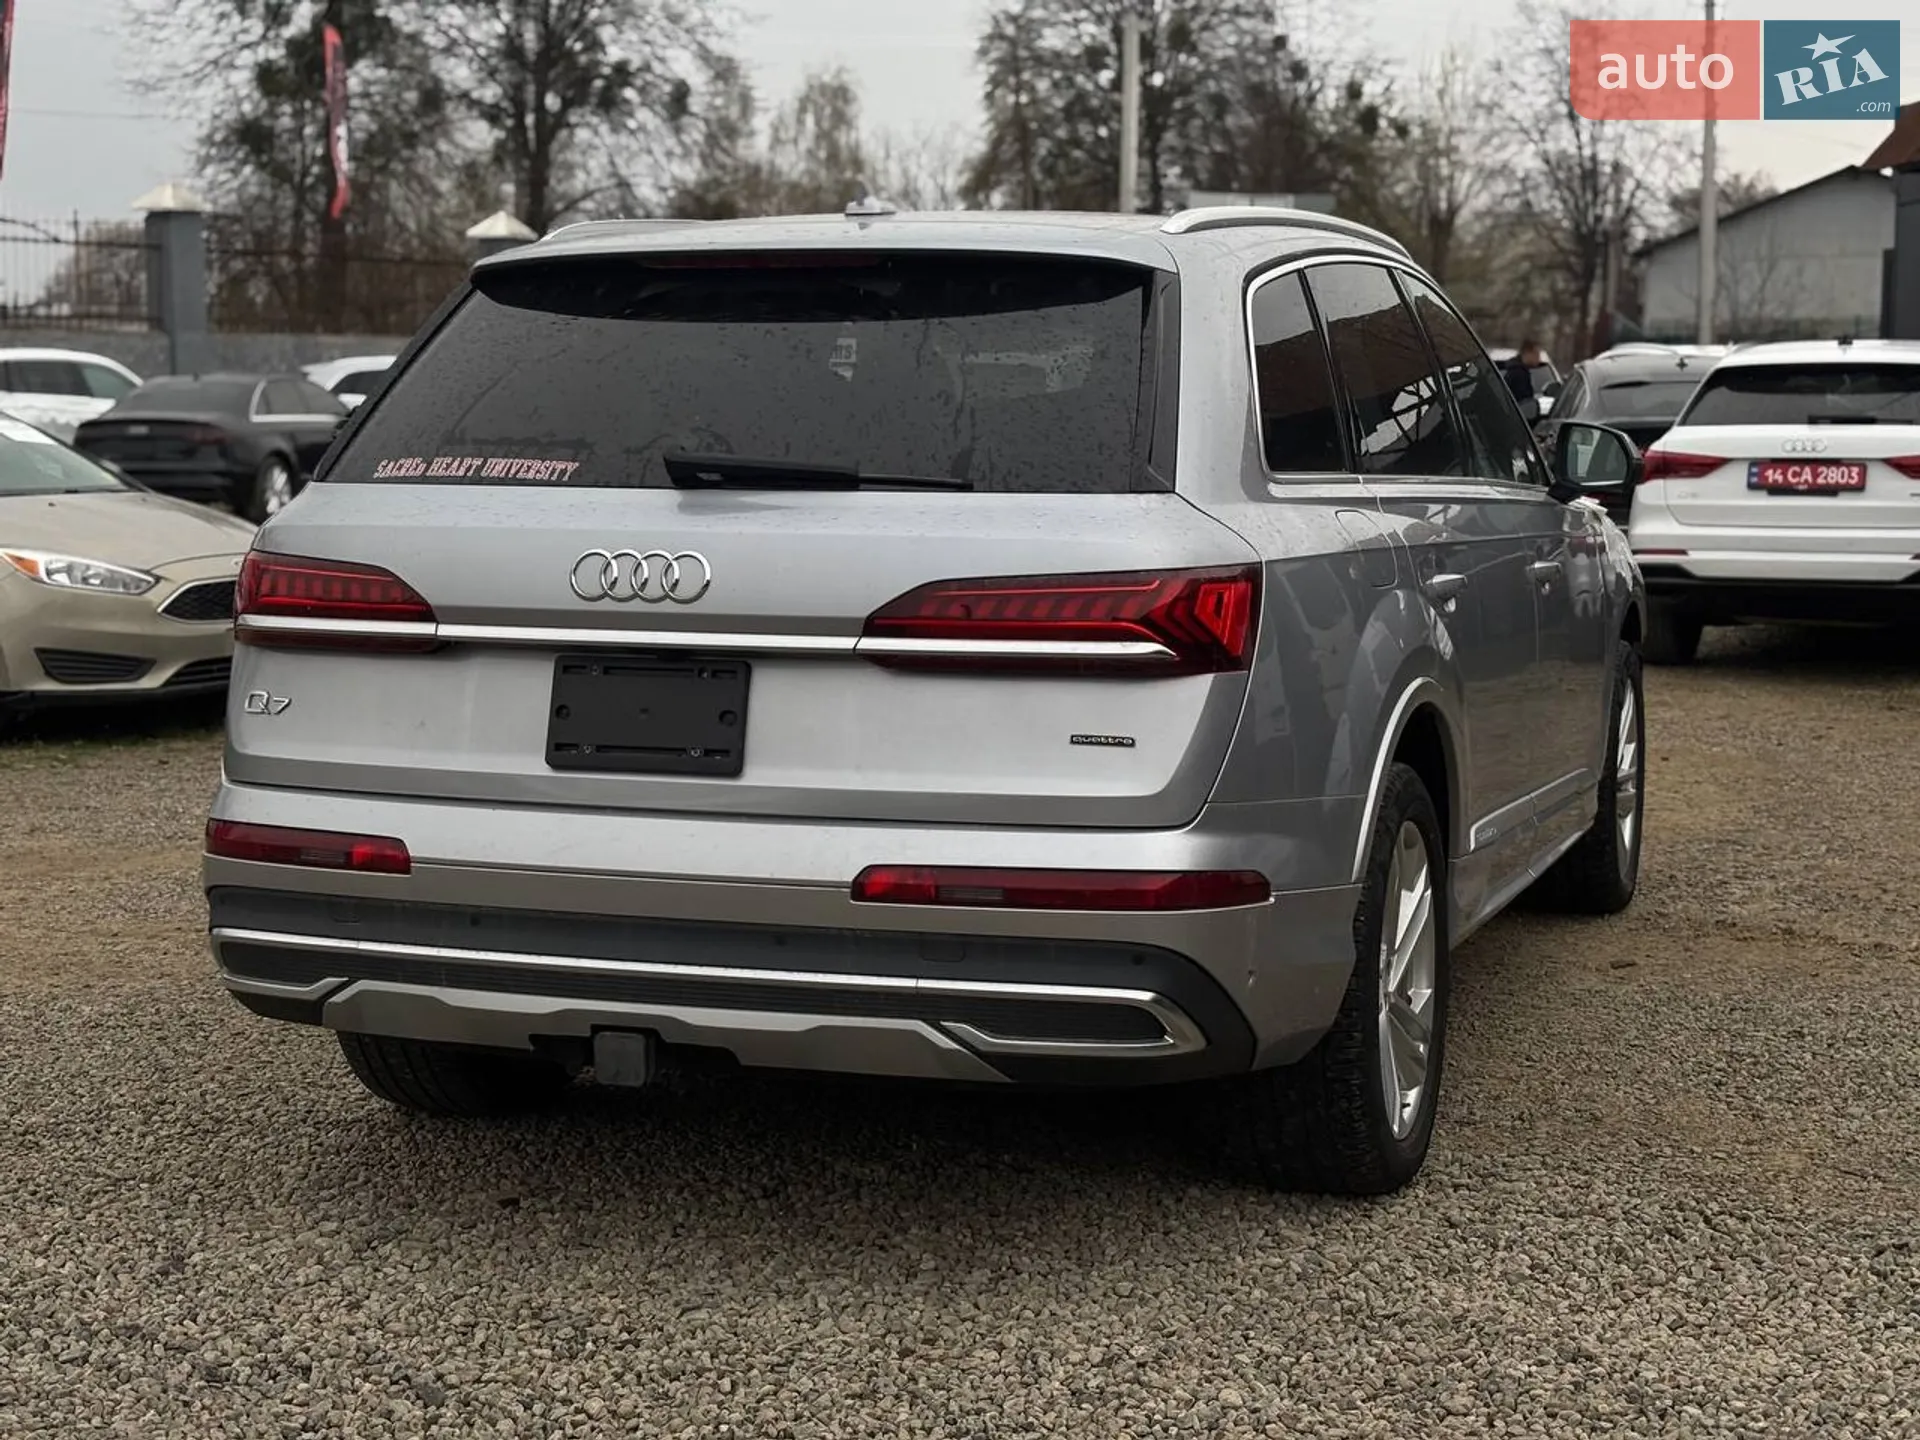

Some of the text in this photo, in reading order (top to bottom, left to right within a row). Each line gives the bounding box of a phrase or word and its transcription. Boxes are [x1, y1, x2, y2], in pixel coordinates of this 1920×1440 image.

[425, 457, 483, 477] HEART
[480, 457, 580, 482] UNIVERSITY
[1764, 468, 1783, 484] 14
[1786, 466, 1813, 484] CA
[1816, 466, 1861, 485] 2803
[244, 691, 292, 715] Q7
[1071, 735, 1134, 746] quattro
